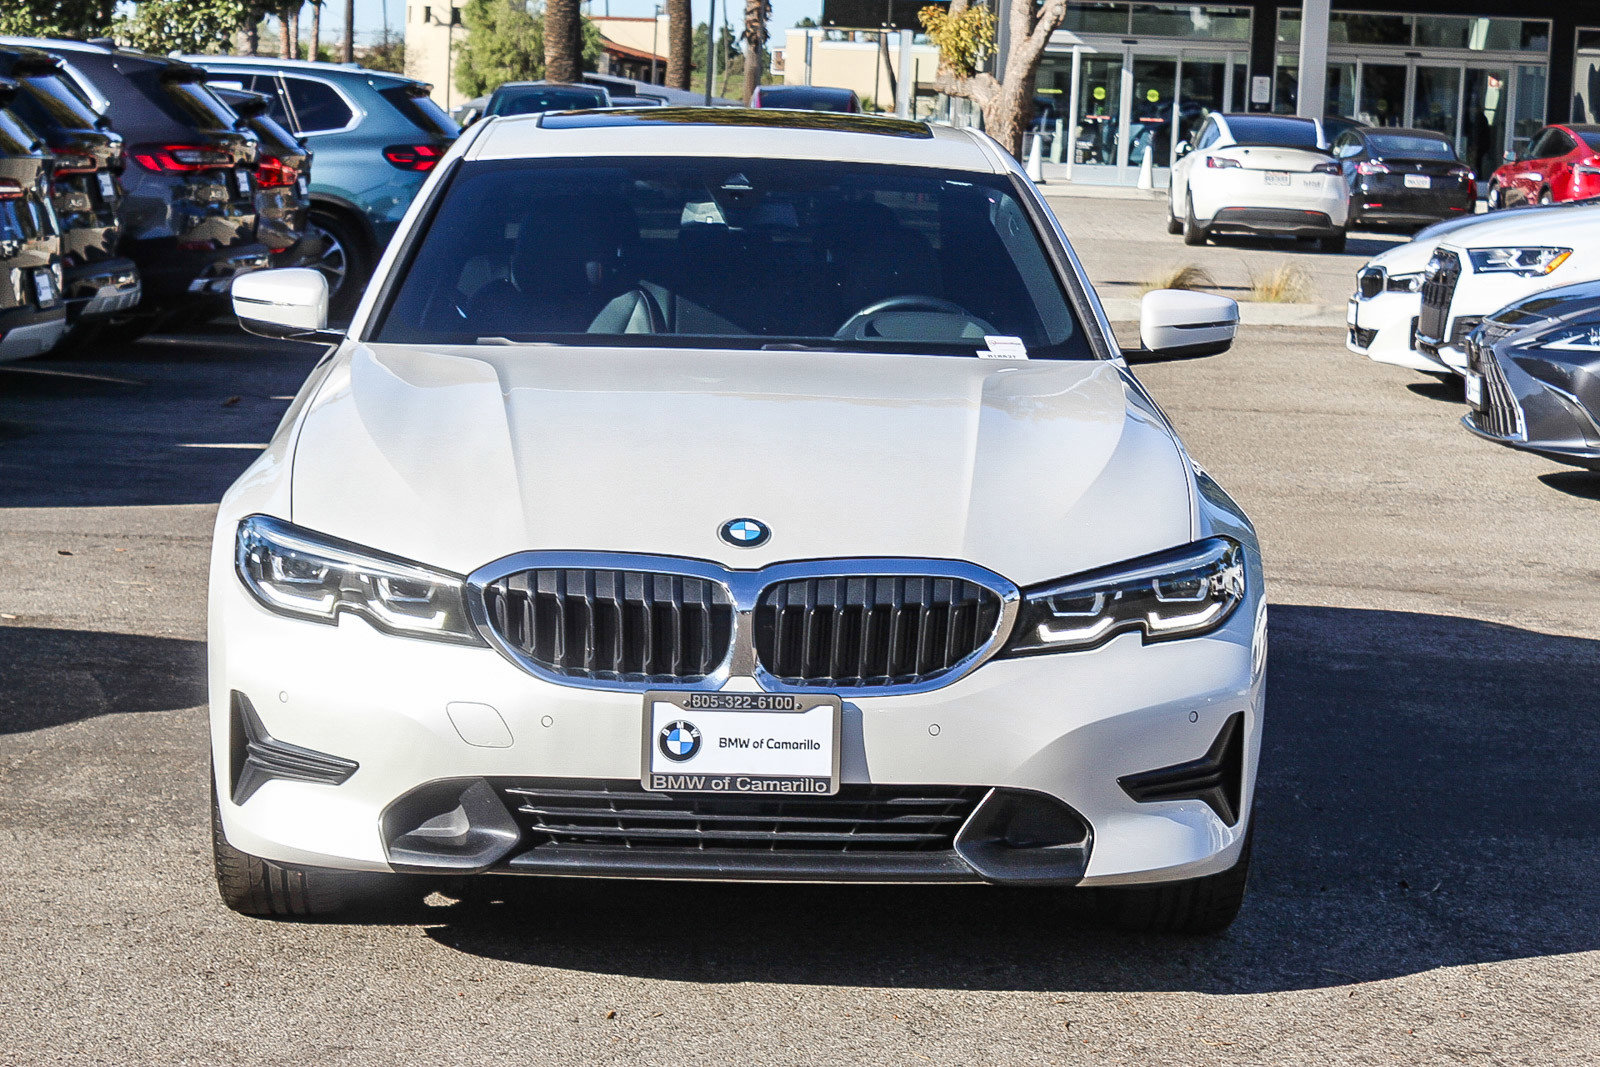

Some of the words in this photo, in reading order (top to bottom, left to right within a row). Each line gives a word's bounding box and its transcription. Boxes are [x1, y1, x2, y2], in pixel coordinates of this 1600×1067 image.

[692, 694, 792, 709] 805-322-6100
[719, 737, 750, 749] BMW
[753, 738, 765, 749] of
[766, 738, 821, 751] Camarillo
[653, 775, 706, 790] BMW
[711, 776, 731, 790] of
[736, 777, 828, 793] Camarillo
